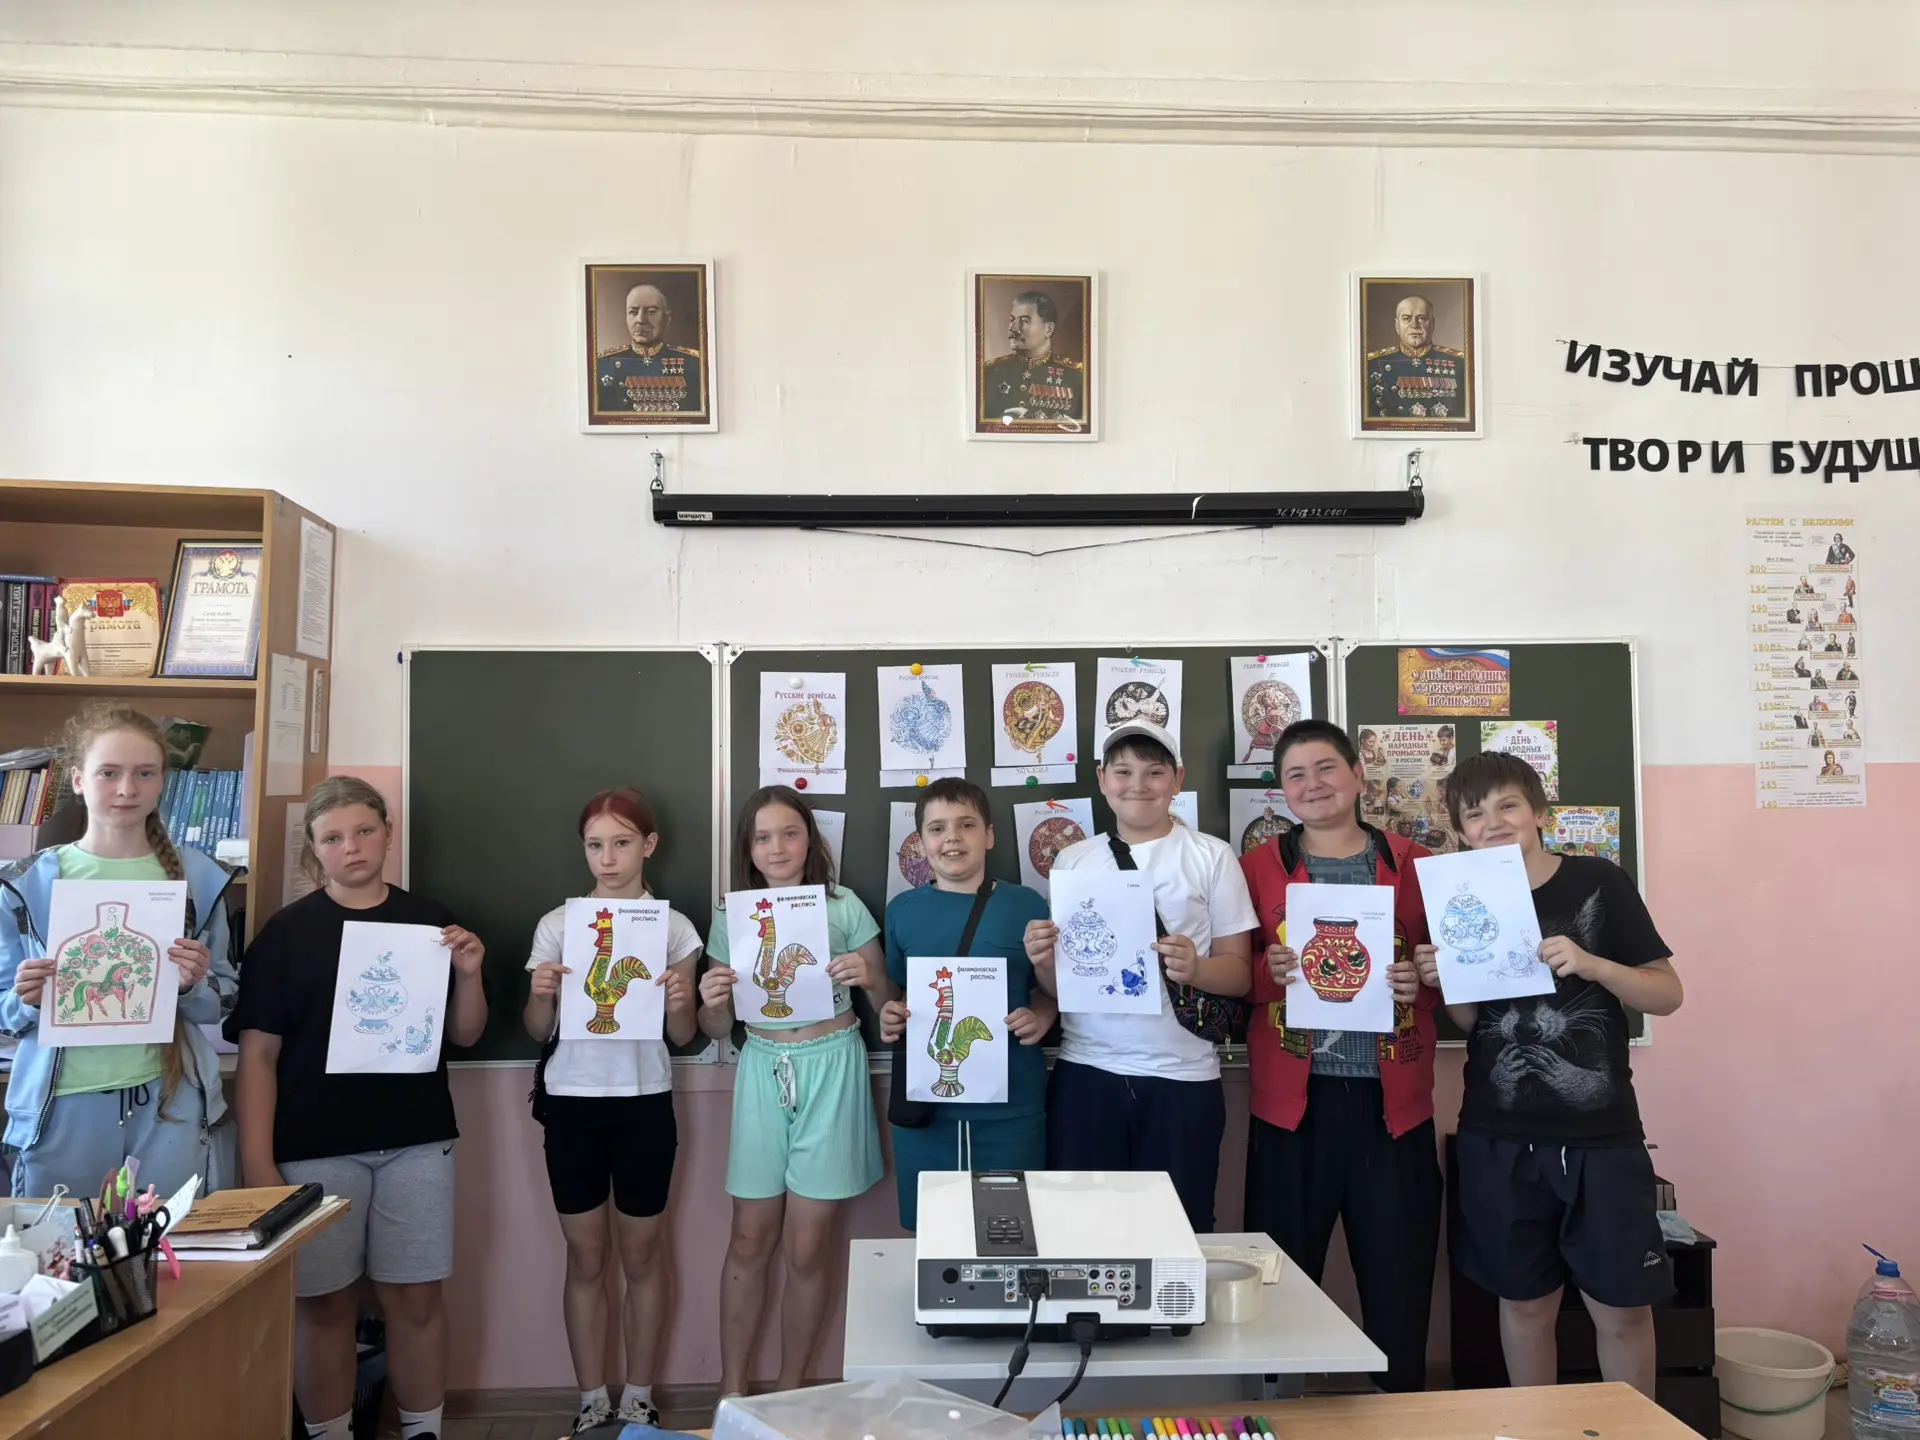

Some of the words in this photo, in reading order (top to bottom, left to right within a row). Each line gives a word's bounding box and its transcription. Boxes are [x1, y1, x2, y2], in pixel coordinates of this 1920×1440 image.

[1565, 340, 1758, 396] ИЗУЧАЙ
[1796, 357, 1920, 397] ПРОШ
[1583, 437, 1745, 473] ТВОРИ
[1803, 518, 1855, 526] ВЕЛИКИМИ
[1750, 565, 1766, 573] 200
[194, 582, 249, 594] ГРАМОТА
[1750, 585, 1767, 593] 195
[1750, 605, 1767, 613] 190
[86, 620, 141, 632] рамота
[1752, 624, 1768, 632] 185
[11, 628, 20, 657] ИСТОРИЯ
[1754, 663, 1771, 671] 175
[1455, 670, 1507, 682] НАРОДНЫХ
[1411, 683, 1507, 695] ХУДОЖЕСТВЕННЫХ
[775, 691, 804, 700] Русские
[1758, 722, 1775, 730] 160
[1393, 732, 1425, 742] ДЕНЬ
[1511, 736, 1532, 745] ДЕНЬ
[1503, 746, 1542, 754] НАРОДНЫХ
[1760, 781, 1777, 789] 145
[791, 902, 816, 910] роспись
[957, 966, 997, 974] филимоновская
